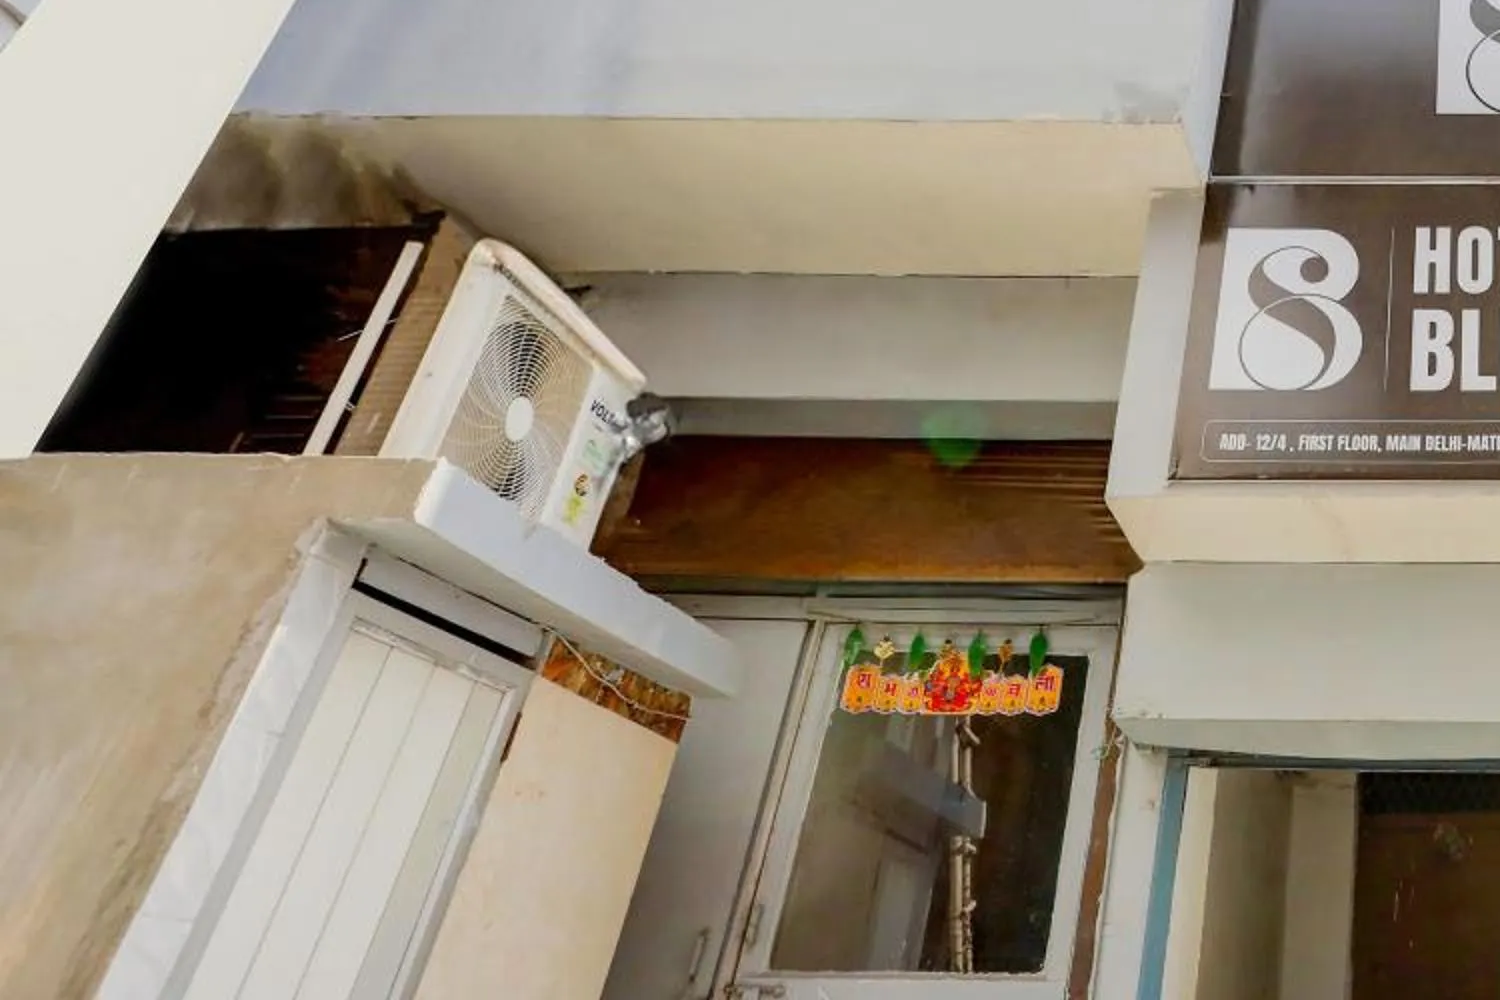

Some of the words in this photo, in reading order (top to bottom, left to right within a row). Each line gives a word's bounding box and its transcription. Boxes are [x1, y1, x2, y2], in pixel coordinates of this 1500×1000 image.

[1219, 433, 1252, 452] ADD-
[1255, 433, 1287, 452] 12/4
[1298, 433, 1334, 452] FIRST
[1336, 433, 1382, 453] FLOOR,
[1385, 433, 1421, 452] MAIN
